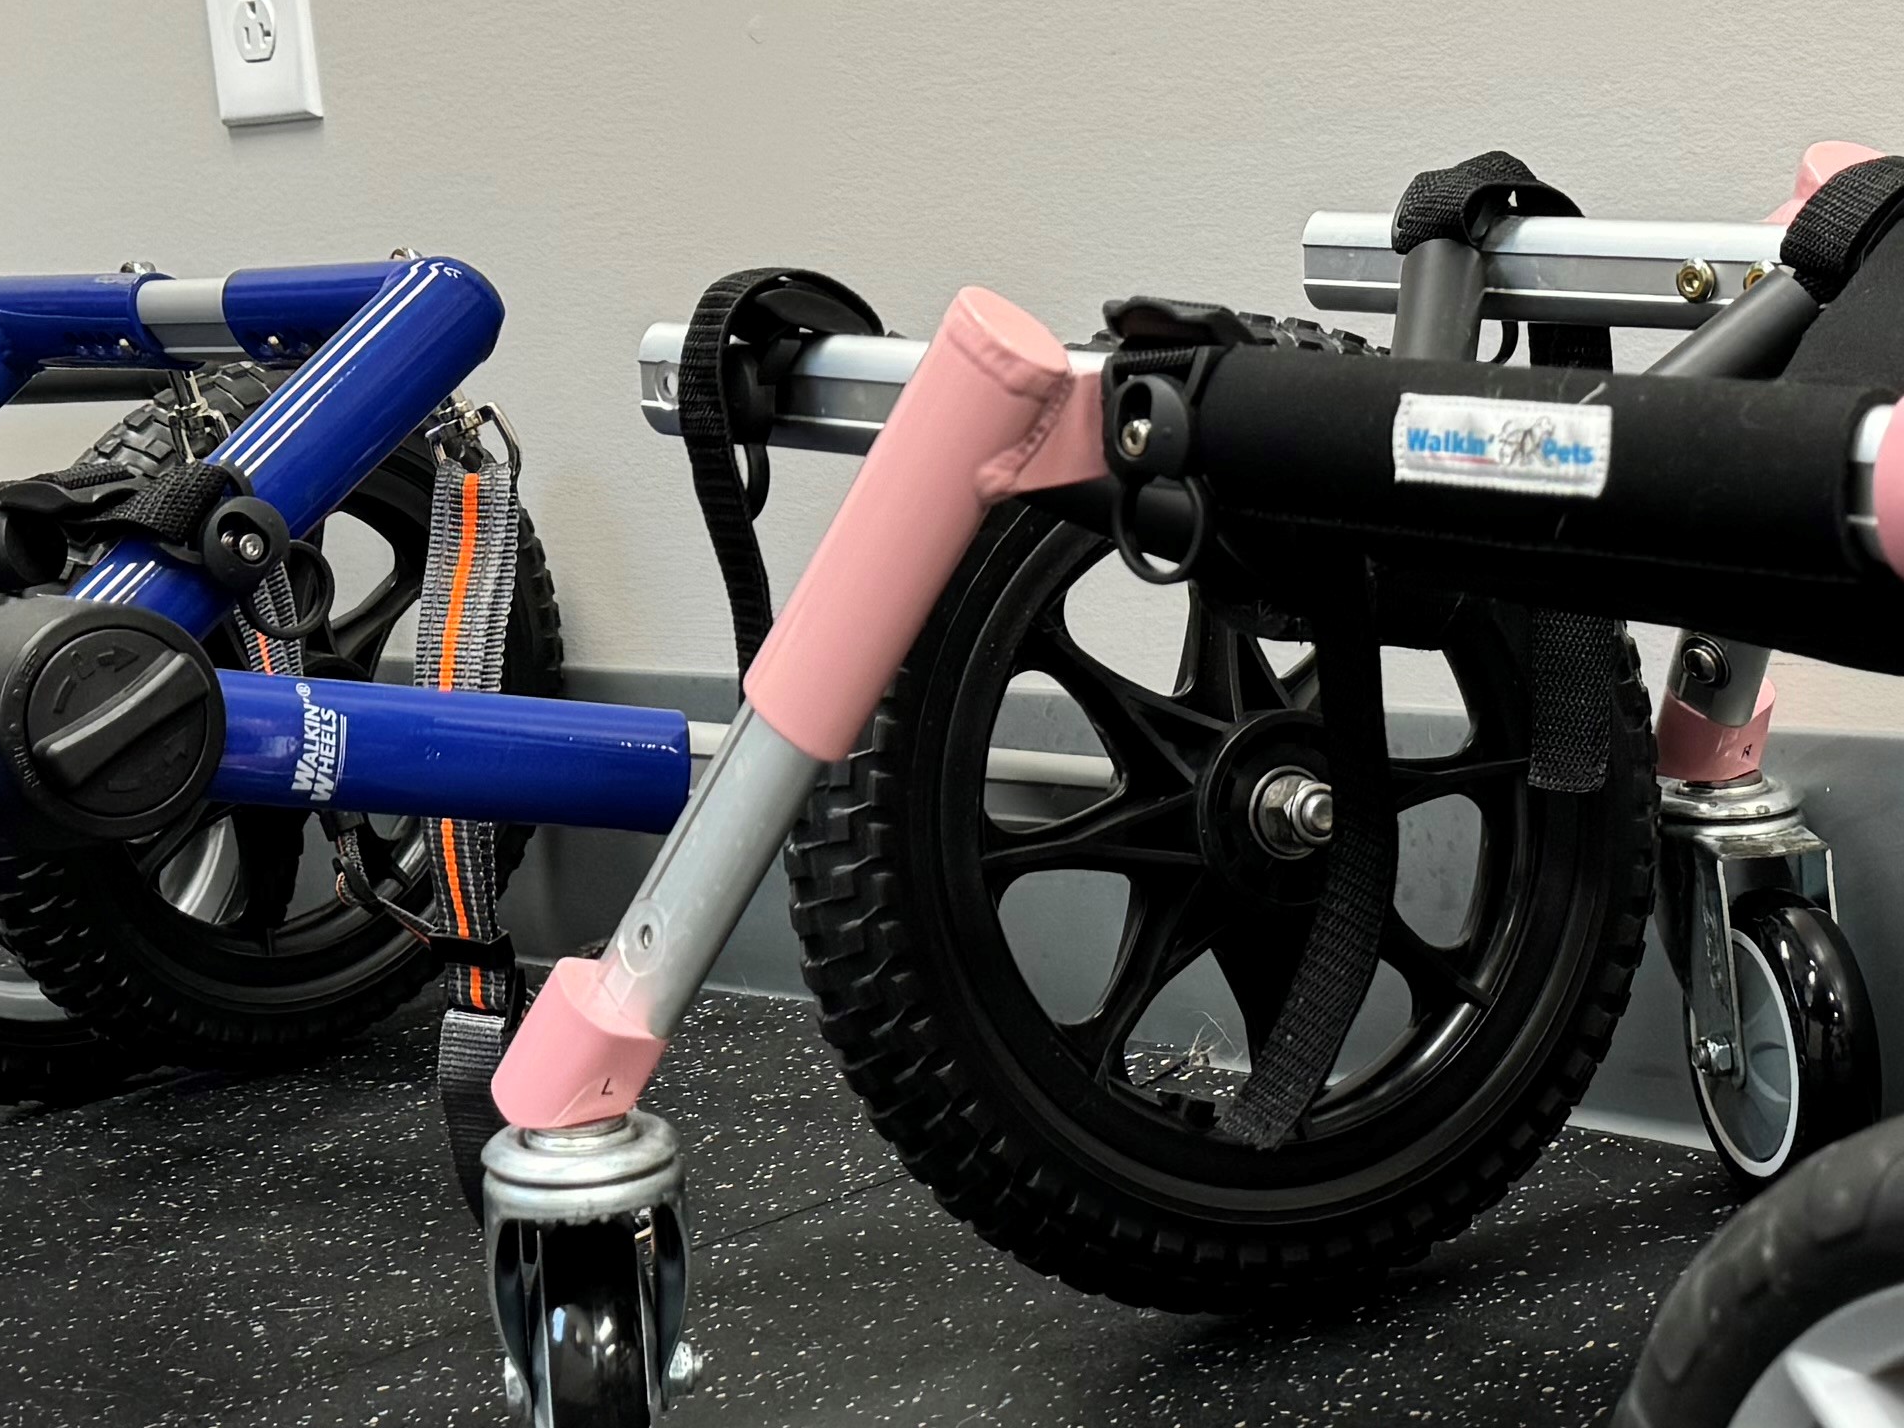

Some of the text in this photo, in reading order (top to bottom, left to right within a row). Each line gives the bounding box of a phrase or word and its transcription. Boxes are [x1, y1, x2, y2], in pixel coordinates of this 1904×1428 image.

[1542, 435, 1595, 465] Pets
[310, 707, 337, 801] WHEELS
[600, 1077, 614, 1096] L
